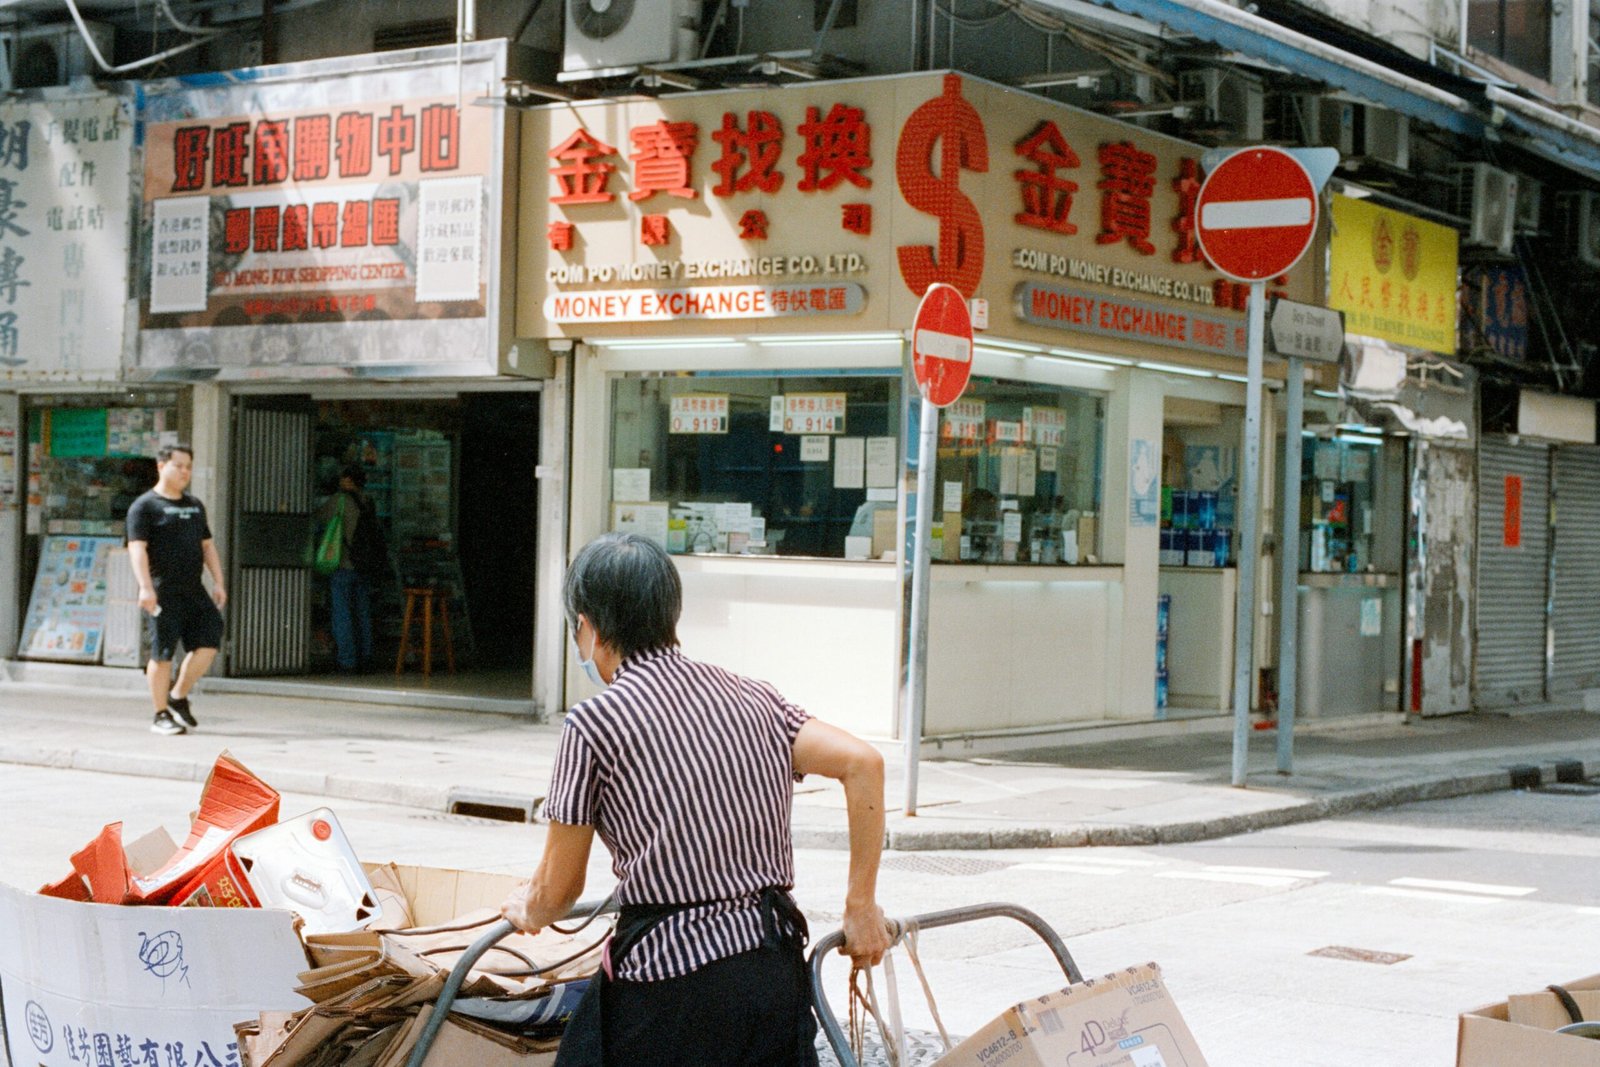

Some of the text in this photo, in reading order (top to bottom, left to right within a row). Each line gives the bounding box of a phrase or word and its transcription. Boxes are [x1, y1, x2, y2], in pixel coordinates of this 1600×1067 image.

[171, 104, 461, 193] 好旺角購物中心
[548, 103, 873, 204] 金寶找換
[547, 203, 872, 251] 有限公司
[299, 264, 358, 283] SHOPPING
[359, 262, 407, 280] CENTER
[546, 252, 866, 284] COM PO MONEY EXCHANGE CO. LTD.
[1017, 249, 1047, 271] COM
[1050, 254, 1067, 275] PO
[1069, 259, 1110, 284] MONEY
[1112, 268, 1172, 297] EXCHANGE
[1174, 281, 1192, 300] CO.
[554, 290, 766, 318] MONEY EXCHANGE
[771, 287, 848, 312] 特快電匯
[1032, 288, 1095, 326] MONEY
[1099, 302, 1187, 342] EXCHANGE
[672, 417, 719, 430] 0.919
[785, 417, 833, 431] 0.914
[976, 1029, 1018, 1063] VC4612-B
[1079, 1020, 1106, 1058] 4D
